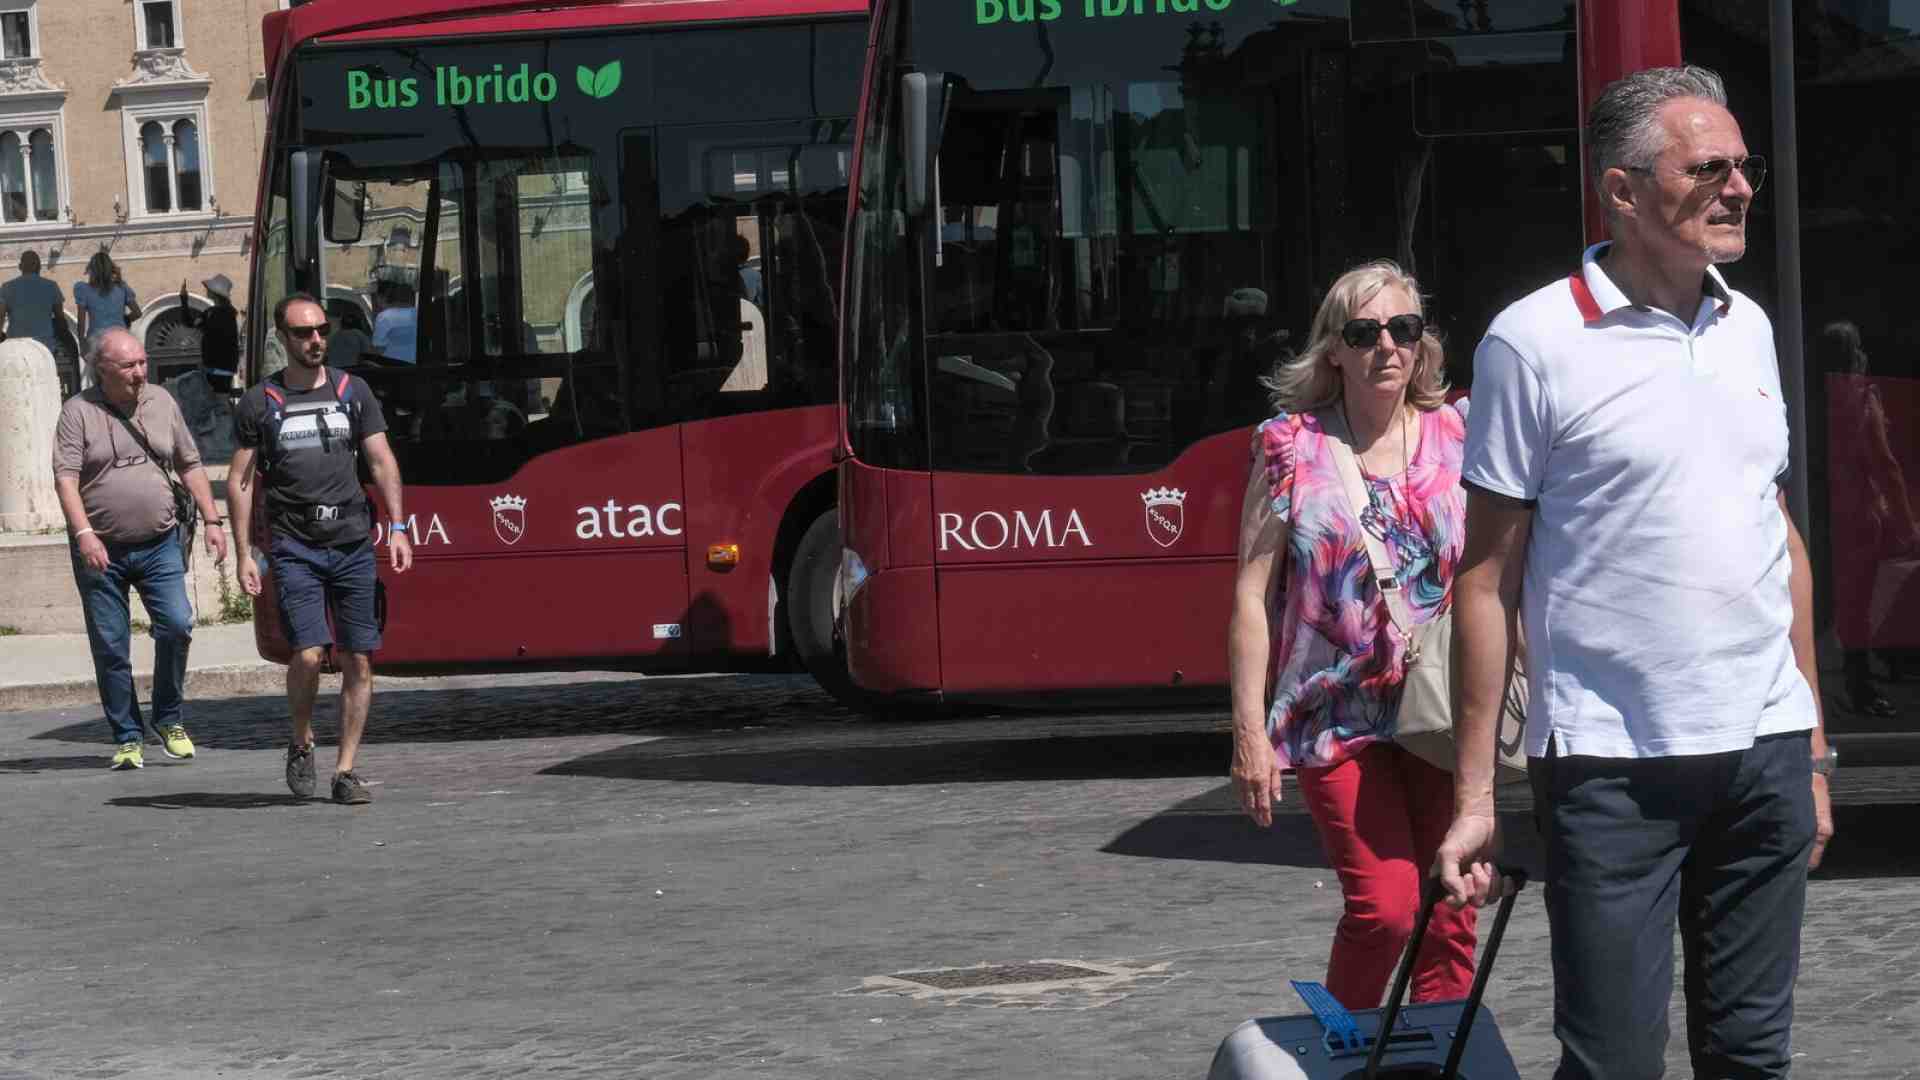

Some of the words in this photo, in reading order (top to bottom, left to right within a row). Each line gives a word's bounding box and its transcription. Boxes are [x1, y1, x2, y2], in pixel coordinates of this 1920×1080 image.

[347, 70, 419, 110] Bus
[436, 63, 558, 106] Ibrido
[575, 499, 683, 539] atac
[938, 508, 1094, 551] ROMA
[1152, 510, 1178, 534] SPQR
